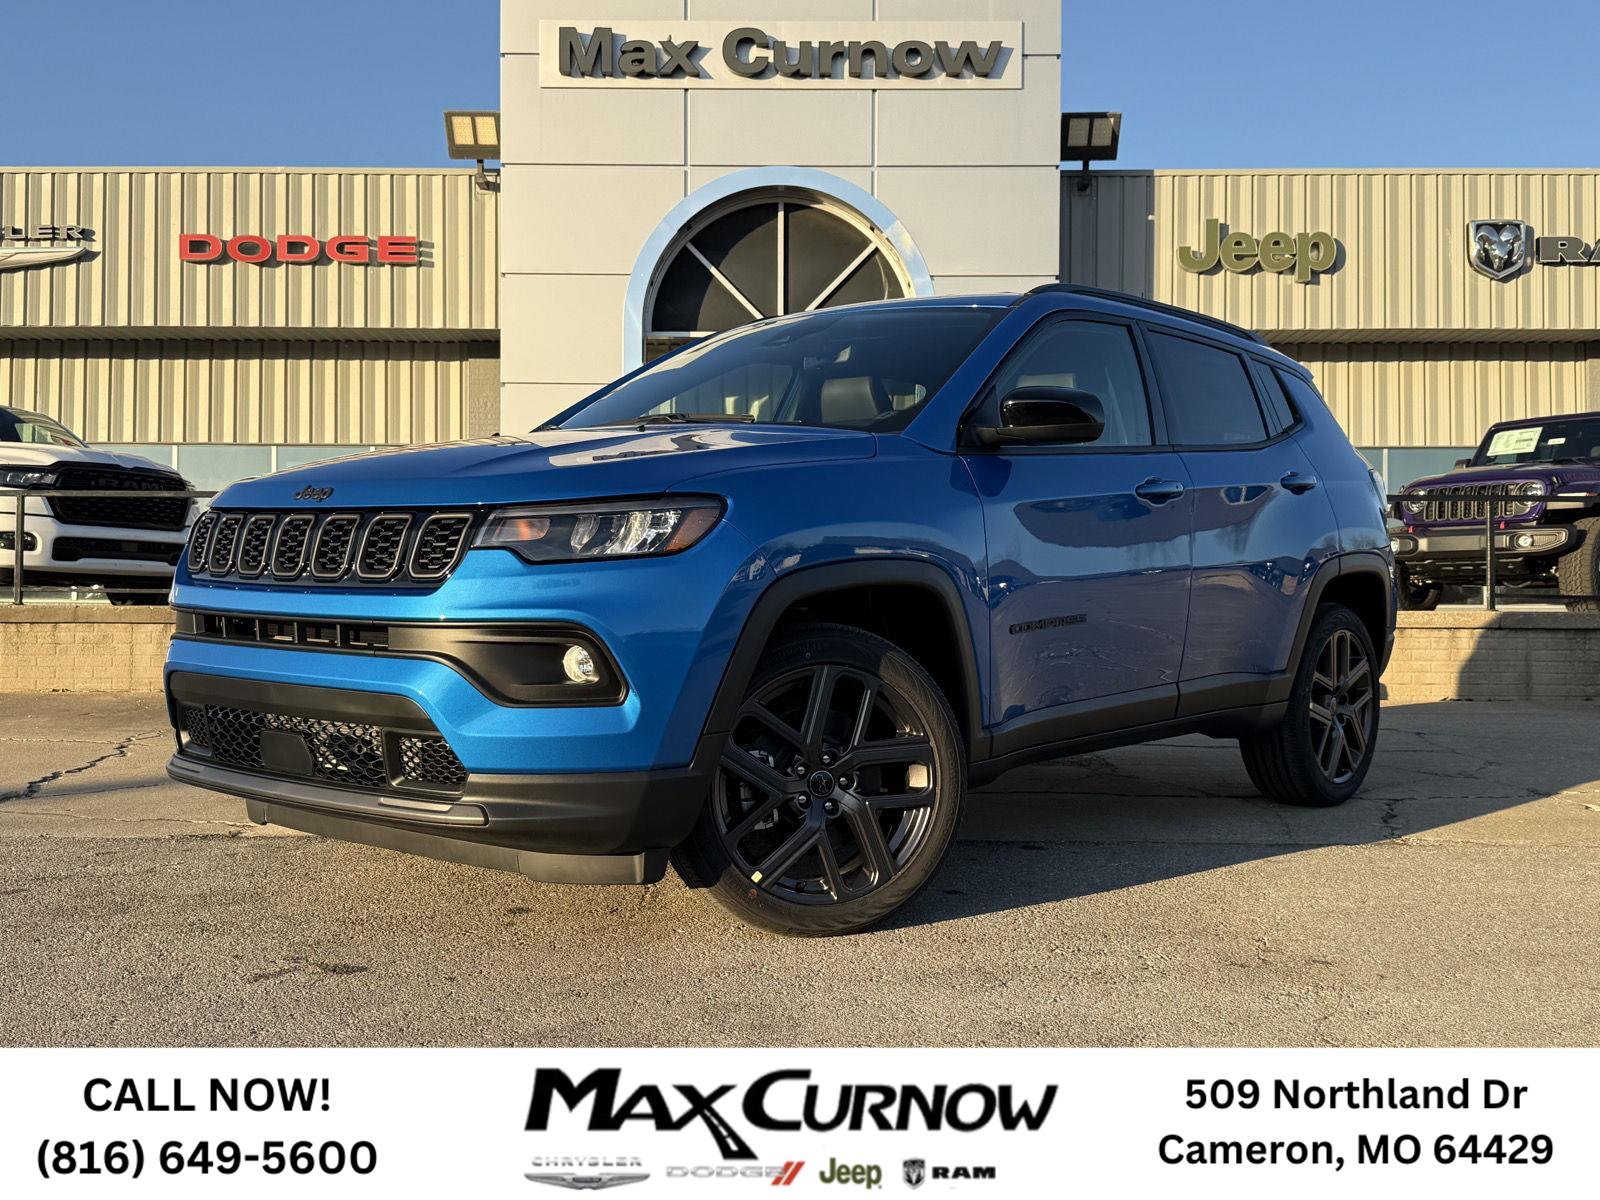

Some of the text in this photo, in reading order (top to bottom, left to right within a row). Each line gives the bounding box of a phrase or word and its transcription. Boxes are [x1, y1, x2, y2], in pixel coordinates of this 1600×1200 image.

[559, 26, 1004, 78] Max Curnow
[179, 233, 419, 264] DODGE
[1177, 218, 1338, 284] Jeep
[294, 484, 334, 503] Jeep
